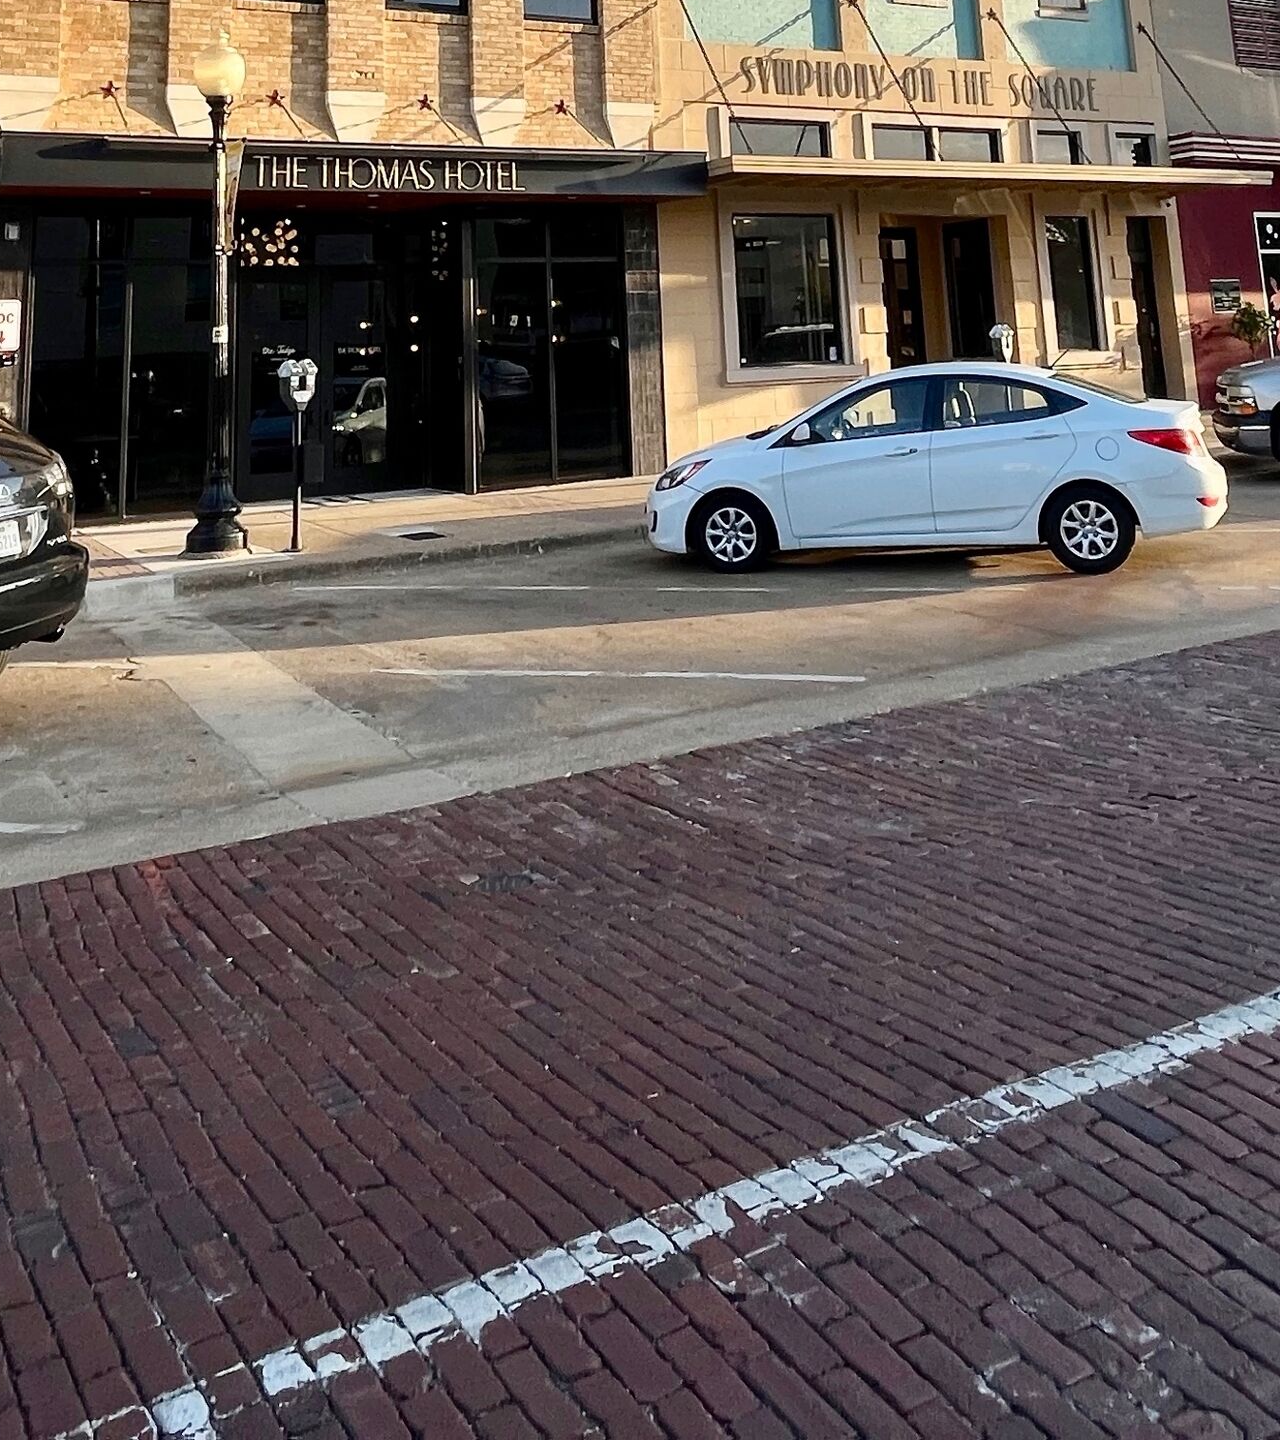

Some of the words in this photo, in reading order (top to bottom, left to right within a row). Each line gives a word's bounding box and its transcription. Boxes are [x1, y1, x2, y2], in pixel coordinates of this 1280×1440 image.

[739, 55, 886, 101] SYMPHONY
[903, 66, 937, 103] ON
[947, 68, 994, 107] THE
[1007, 72, 1100, 112] SQUARE
[252, 155, 308, 188] THE
[316, 157, 435, 190] THOMAS
[444, 160, 526, 192] HOTEL
